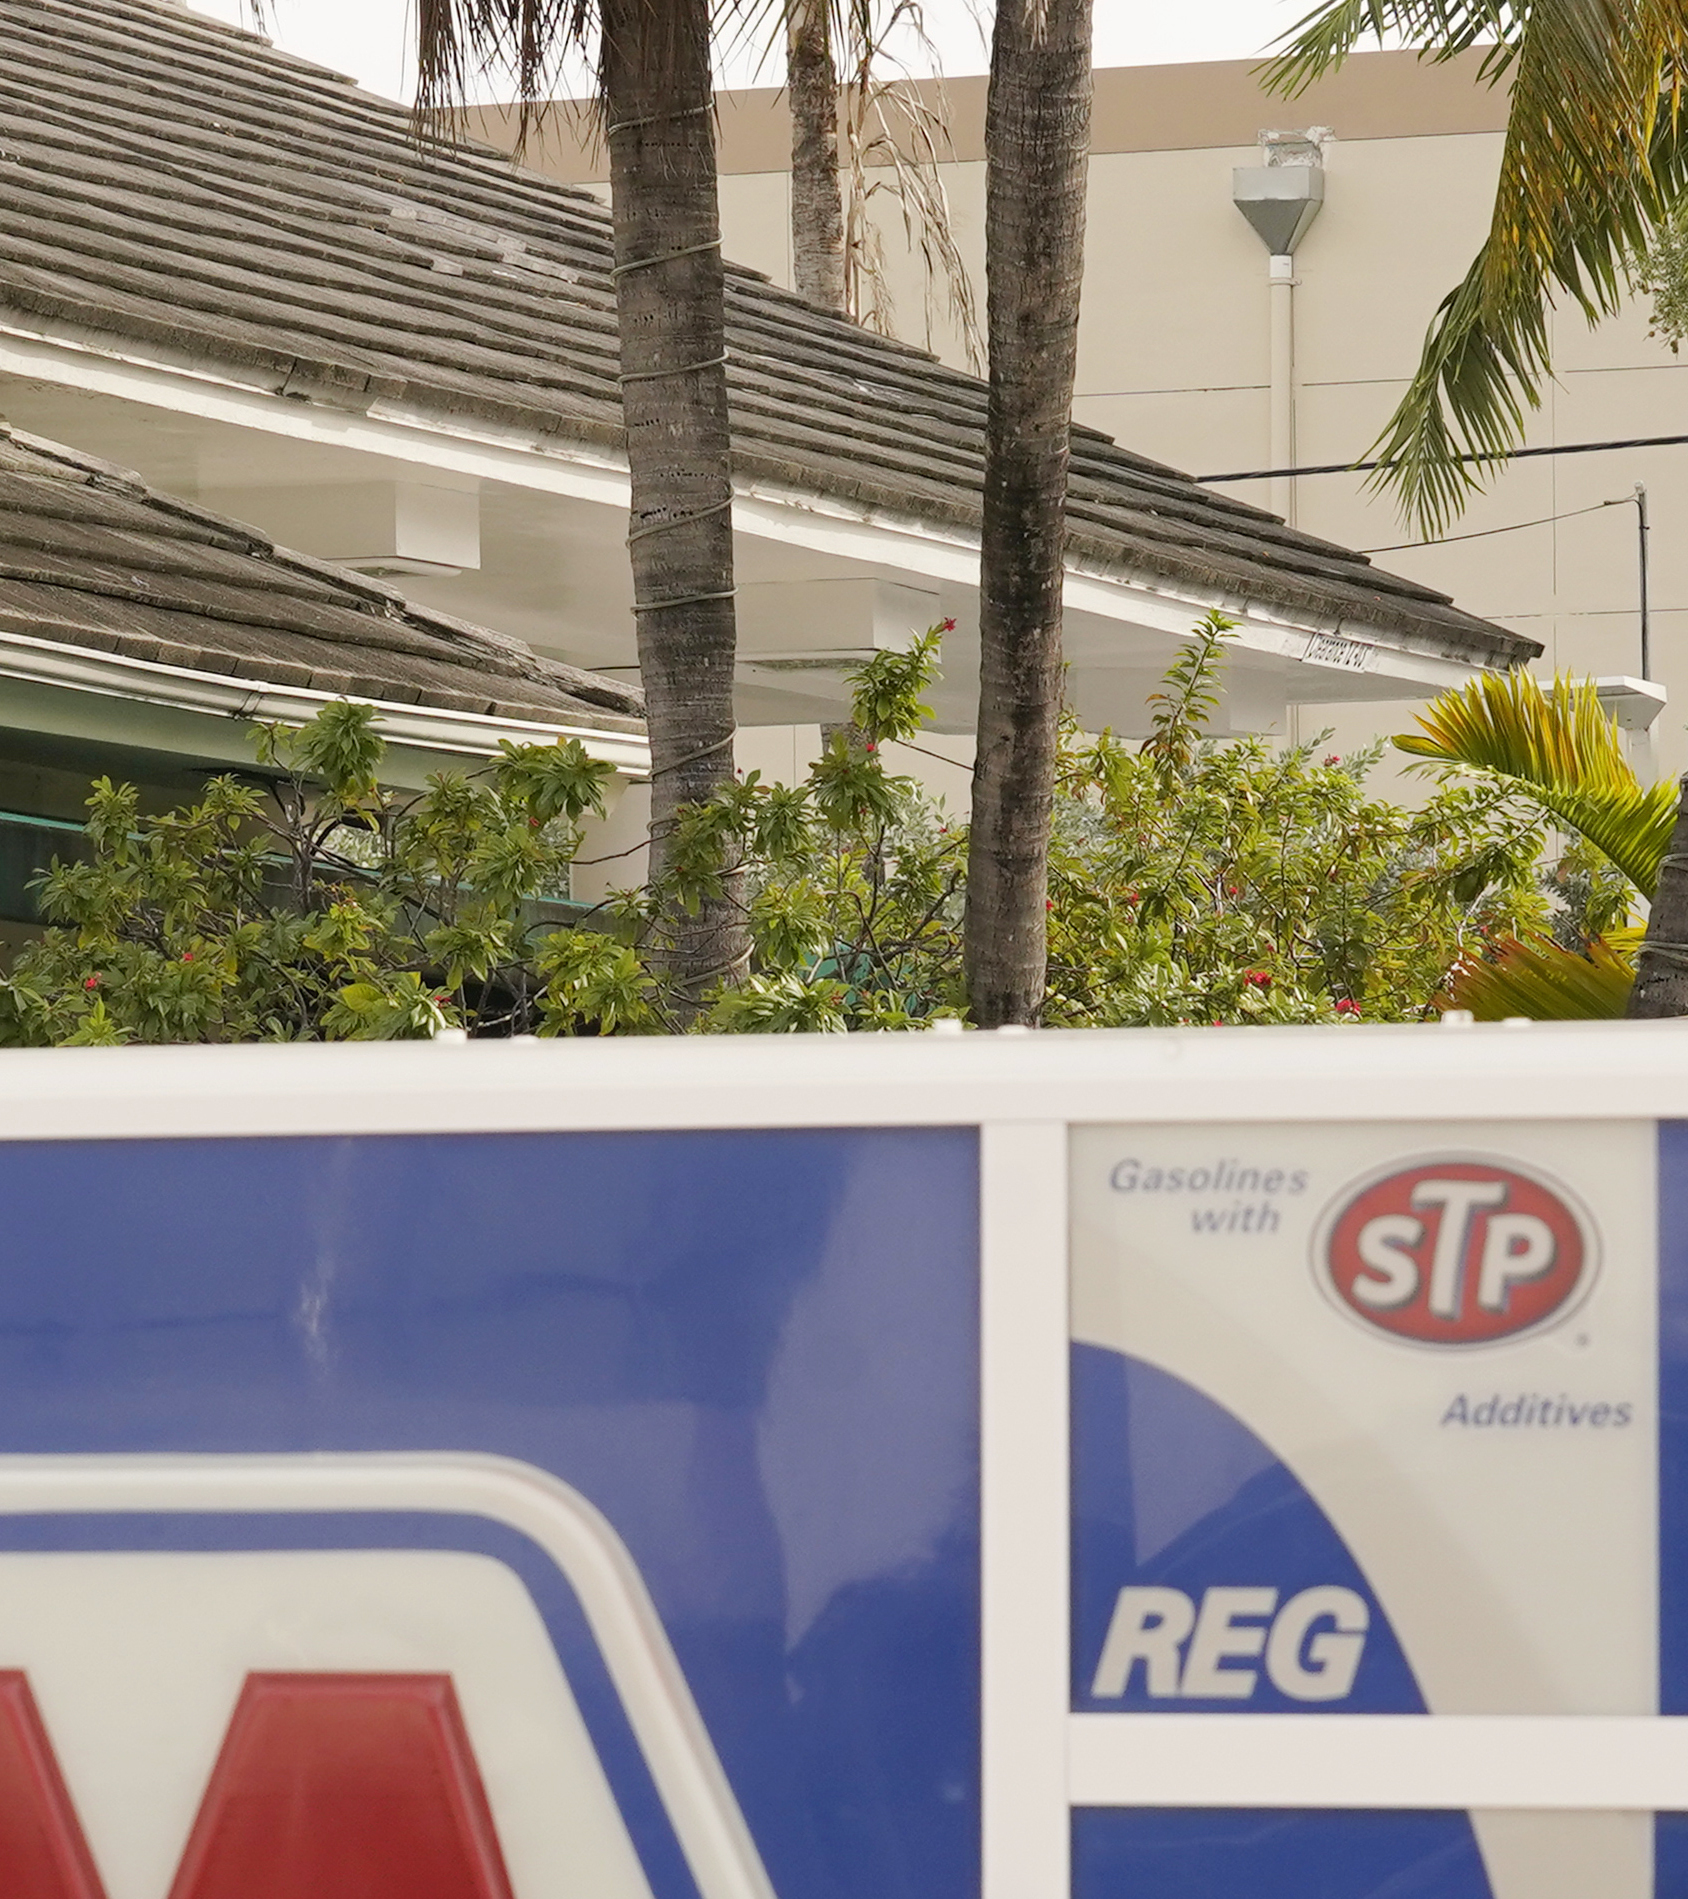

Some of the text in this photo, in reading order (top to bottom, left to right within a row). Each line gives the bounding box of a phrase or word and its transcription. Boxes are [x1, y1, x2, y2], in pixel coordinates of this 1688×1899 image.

[1108, 1157, 1310, 1197] Gasolines
[1190, 1200, 1281, 1235] with
[1350, 1178, 1558, 1323] STP
[1441, 1393, 1633, 1428] Additives
[1090, 1584, 1371, 1704] REG
